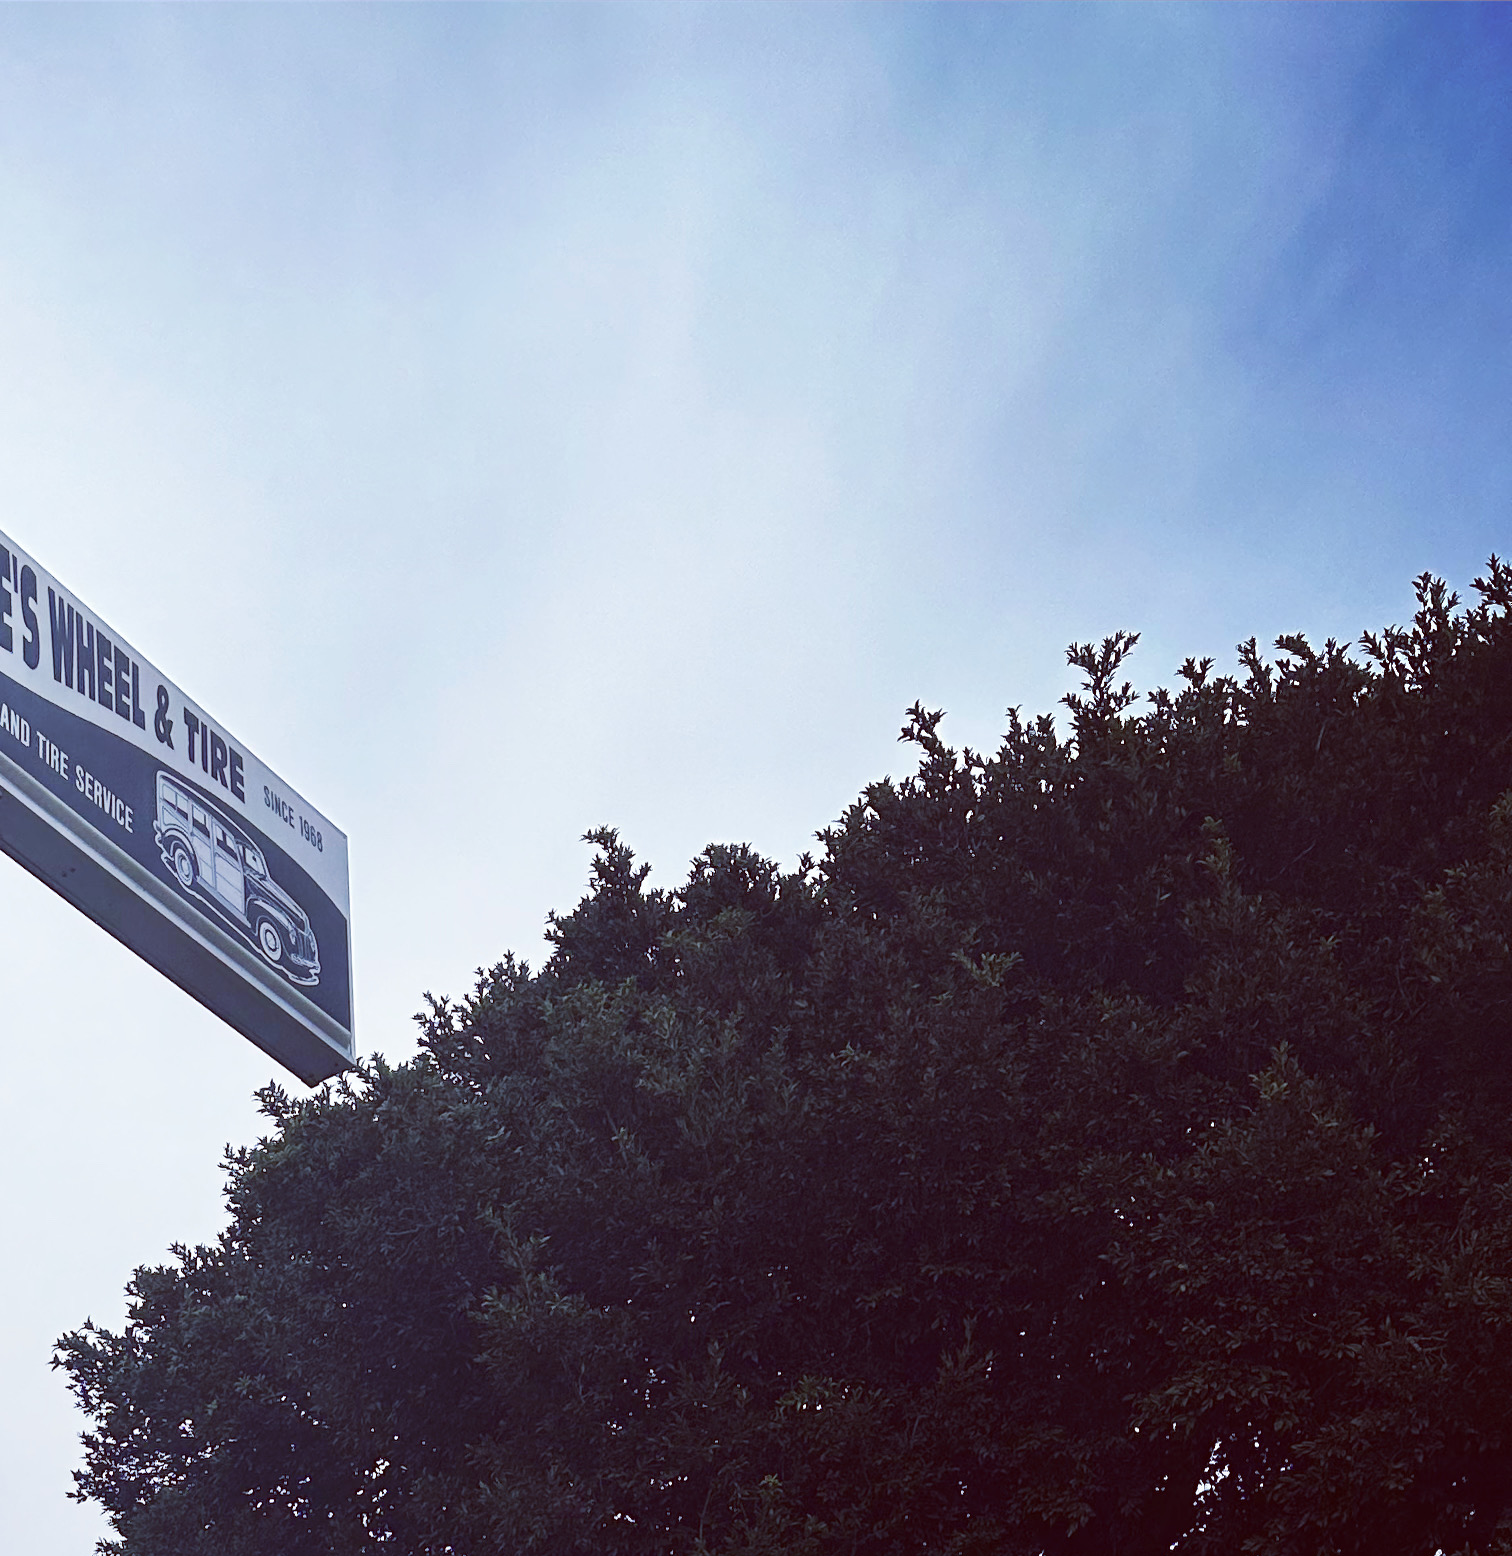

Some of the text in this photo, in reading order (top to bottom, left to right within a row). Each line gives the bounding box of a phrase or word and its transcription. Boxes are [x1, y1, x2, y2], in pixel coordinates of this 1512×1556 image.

[48, 586, 146, 729] WHEEL
[154, 685, 174, 749] &
[184, 707, 245, 803] TIRE
[0, 708, 31, 748] AND
[36, 731, 70, 781] TIRE
[75, 765, 134, 834] SERVICE
[263, 786, 324, 853] SINCE 1968
